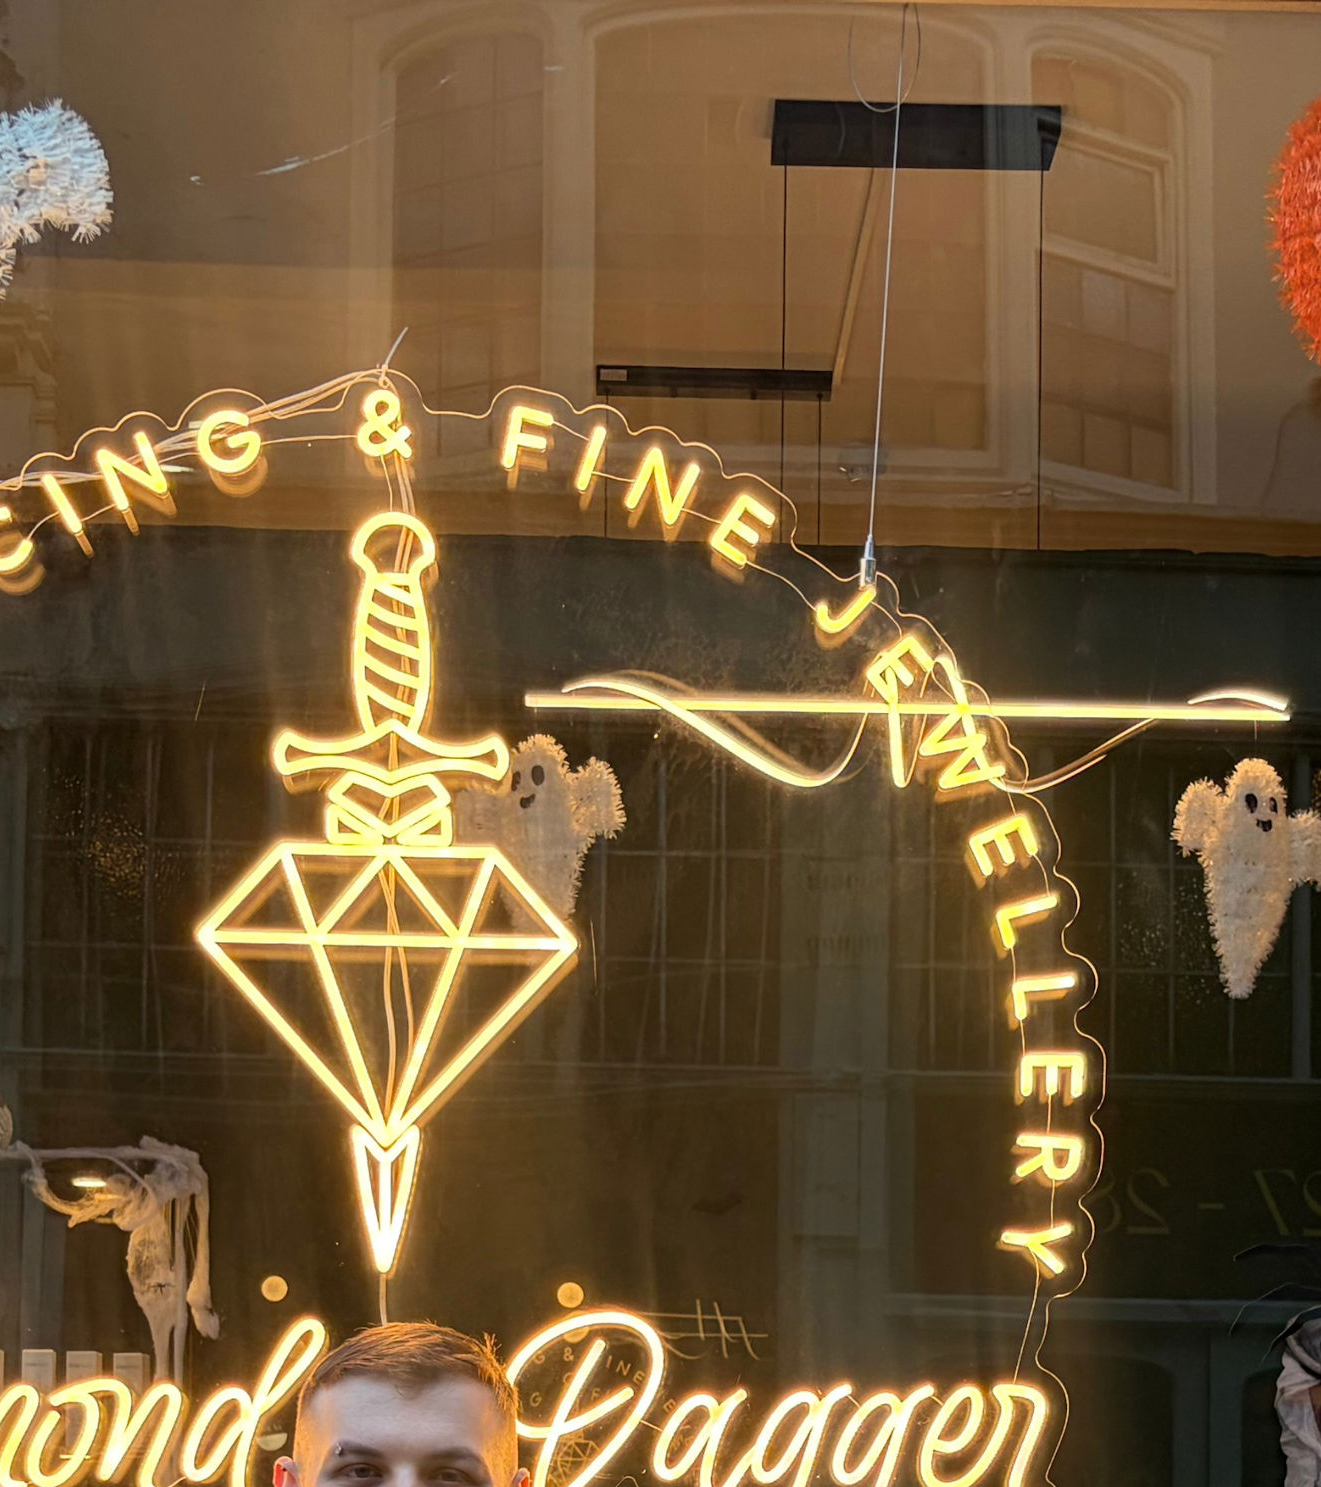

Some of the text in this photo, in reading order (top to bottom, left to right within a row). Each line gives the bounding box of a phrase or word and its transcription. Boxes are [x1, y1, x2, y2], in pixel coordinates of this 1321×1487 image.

[357, 389, 412, 458] &
[502, 405, 776, 567] FINE
[814, 587, 1084, 1275] JEWELLERY
